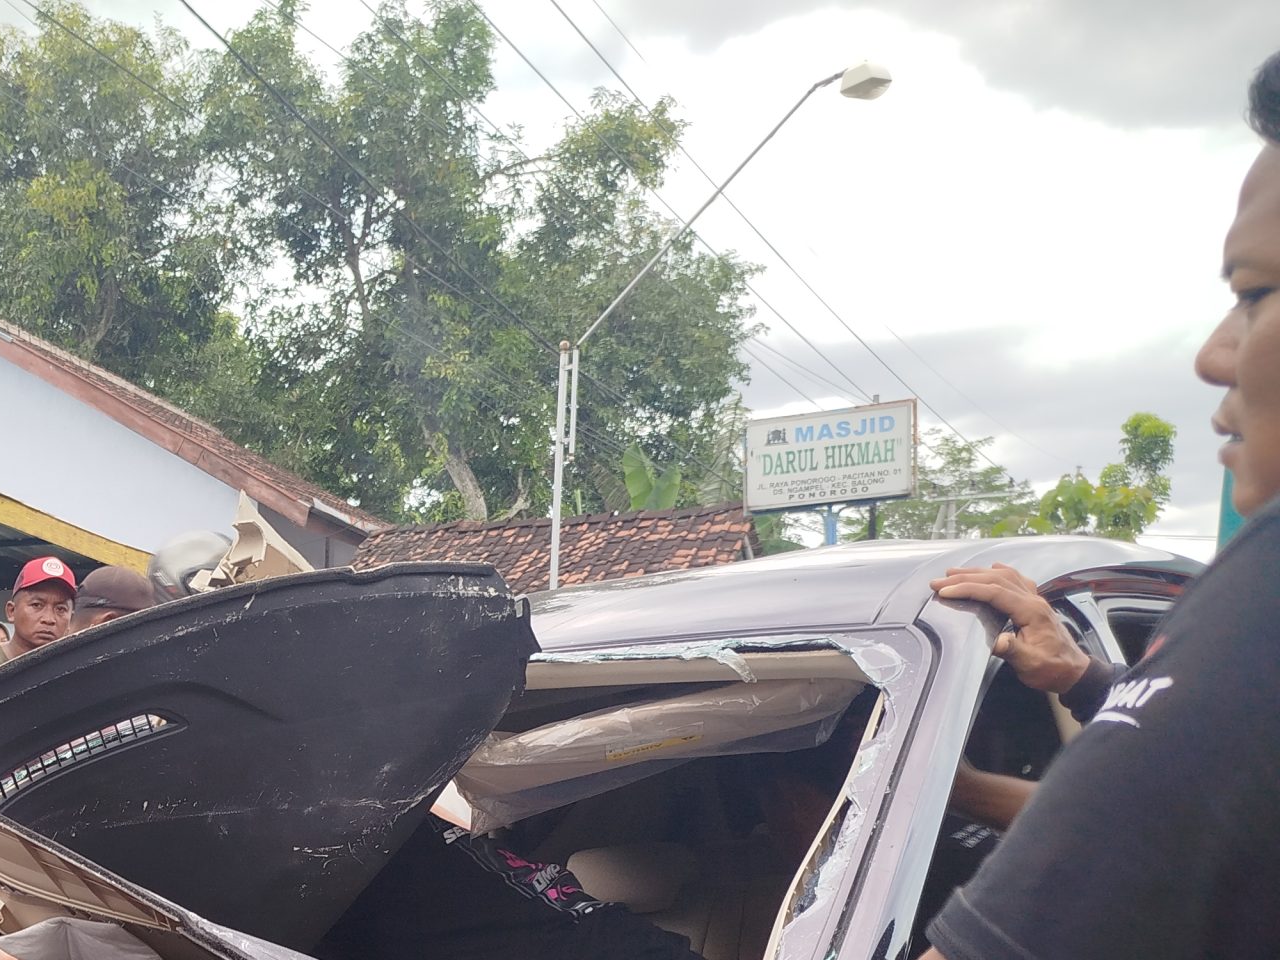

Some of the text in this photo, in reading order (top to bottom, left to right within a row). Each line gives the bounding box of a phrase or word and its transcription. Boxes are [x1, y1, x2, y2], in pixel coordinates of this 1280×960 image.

[795, 415, 896, 442] MASJID
[769, 481, 789, 489] RAYA
[790, 475, 836, 486] PONOROGO
[842, 471, 875, 481] PACITAN
[787, 484, 825, 494] NGAMPEL
[851, 477, 886, 487] BALONG
